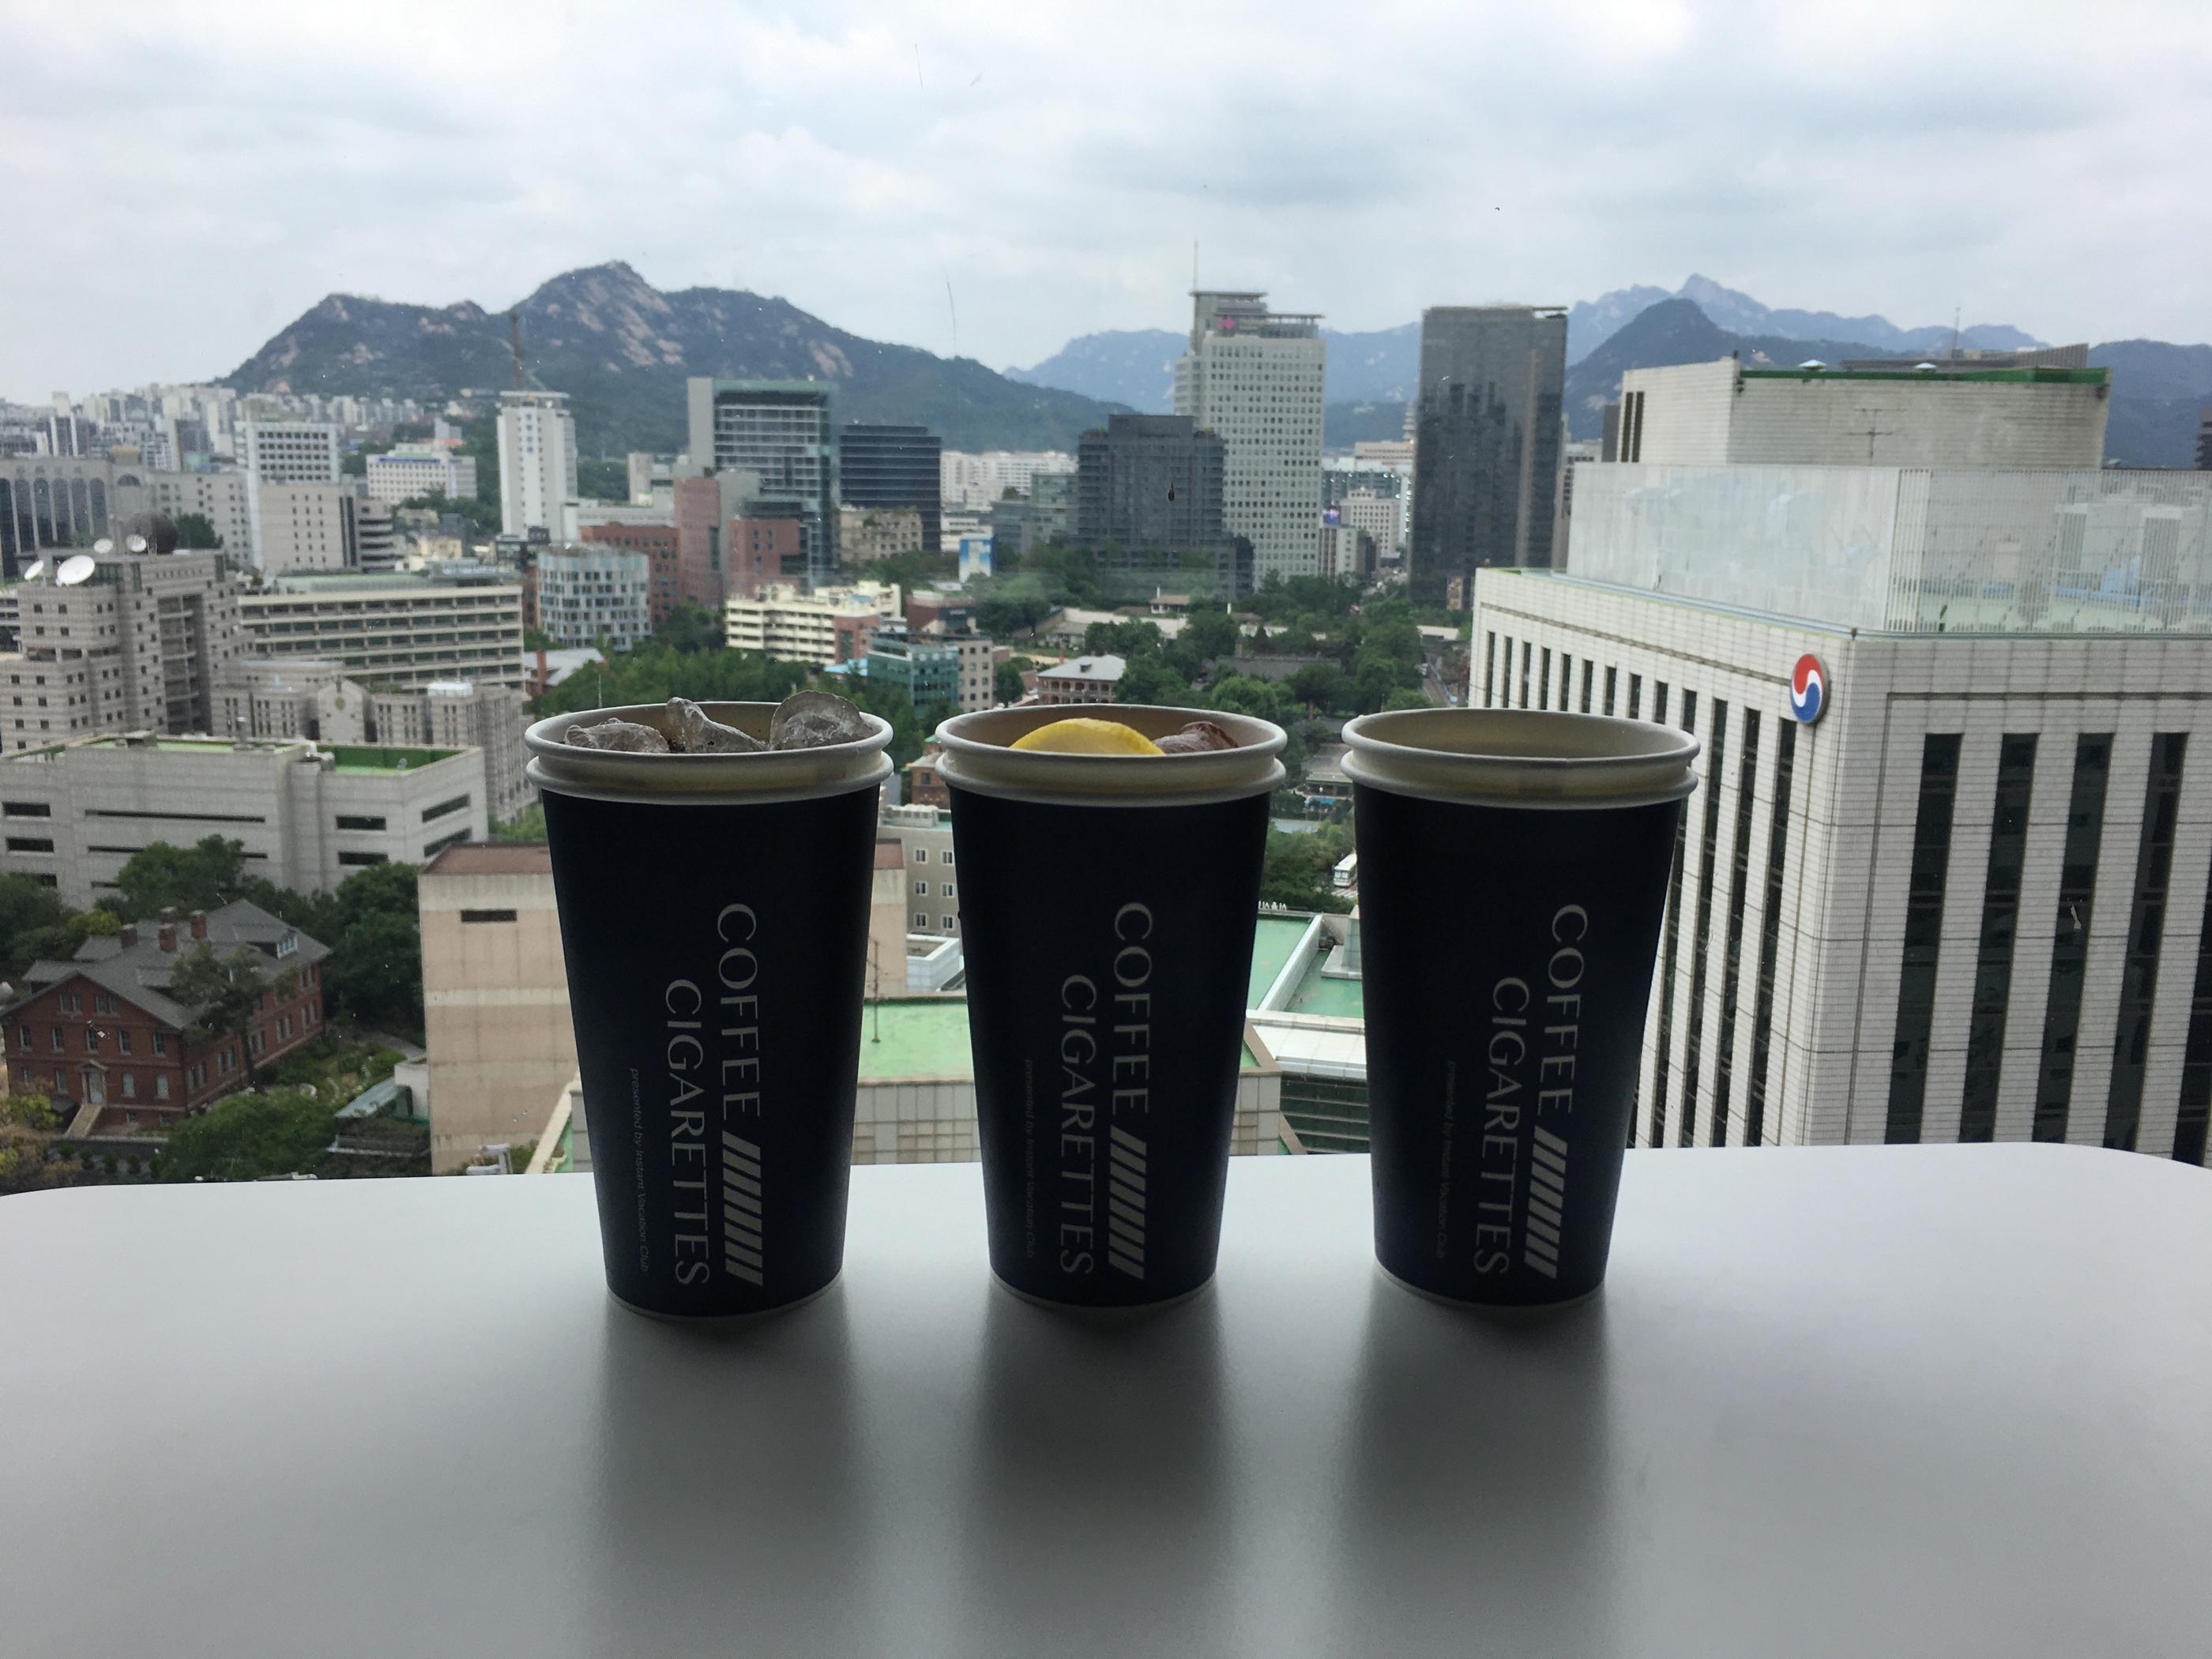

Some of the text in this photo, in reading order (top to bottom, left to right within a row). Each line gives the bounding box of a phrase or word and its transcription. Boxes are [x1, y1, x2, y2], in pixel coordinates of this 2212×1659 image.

[717, 902, 761, 1121] COFFEE
[1112, 901, 1153, 1116] COFFEE
[1537, 903, 1589, 1117] COFFEE
[630, 1068, 649, 1273] presented by Instant Vacation Club
[665, 979, 710, 1287] CIGARETTES
[1024, 1059, 1036, 1258] presented by Instant Vacation Club
[1060, 974, 1097, 1275] CIGARETTES
[1435, 1060, 1458, 1258] presented by Instant Vacation Club
[1473, 976, 1530, 1275] CIGARETTES
